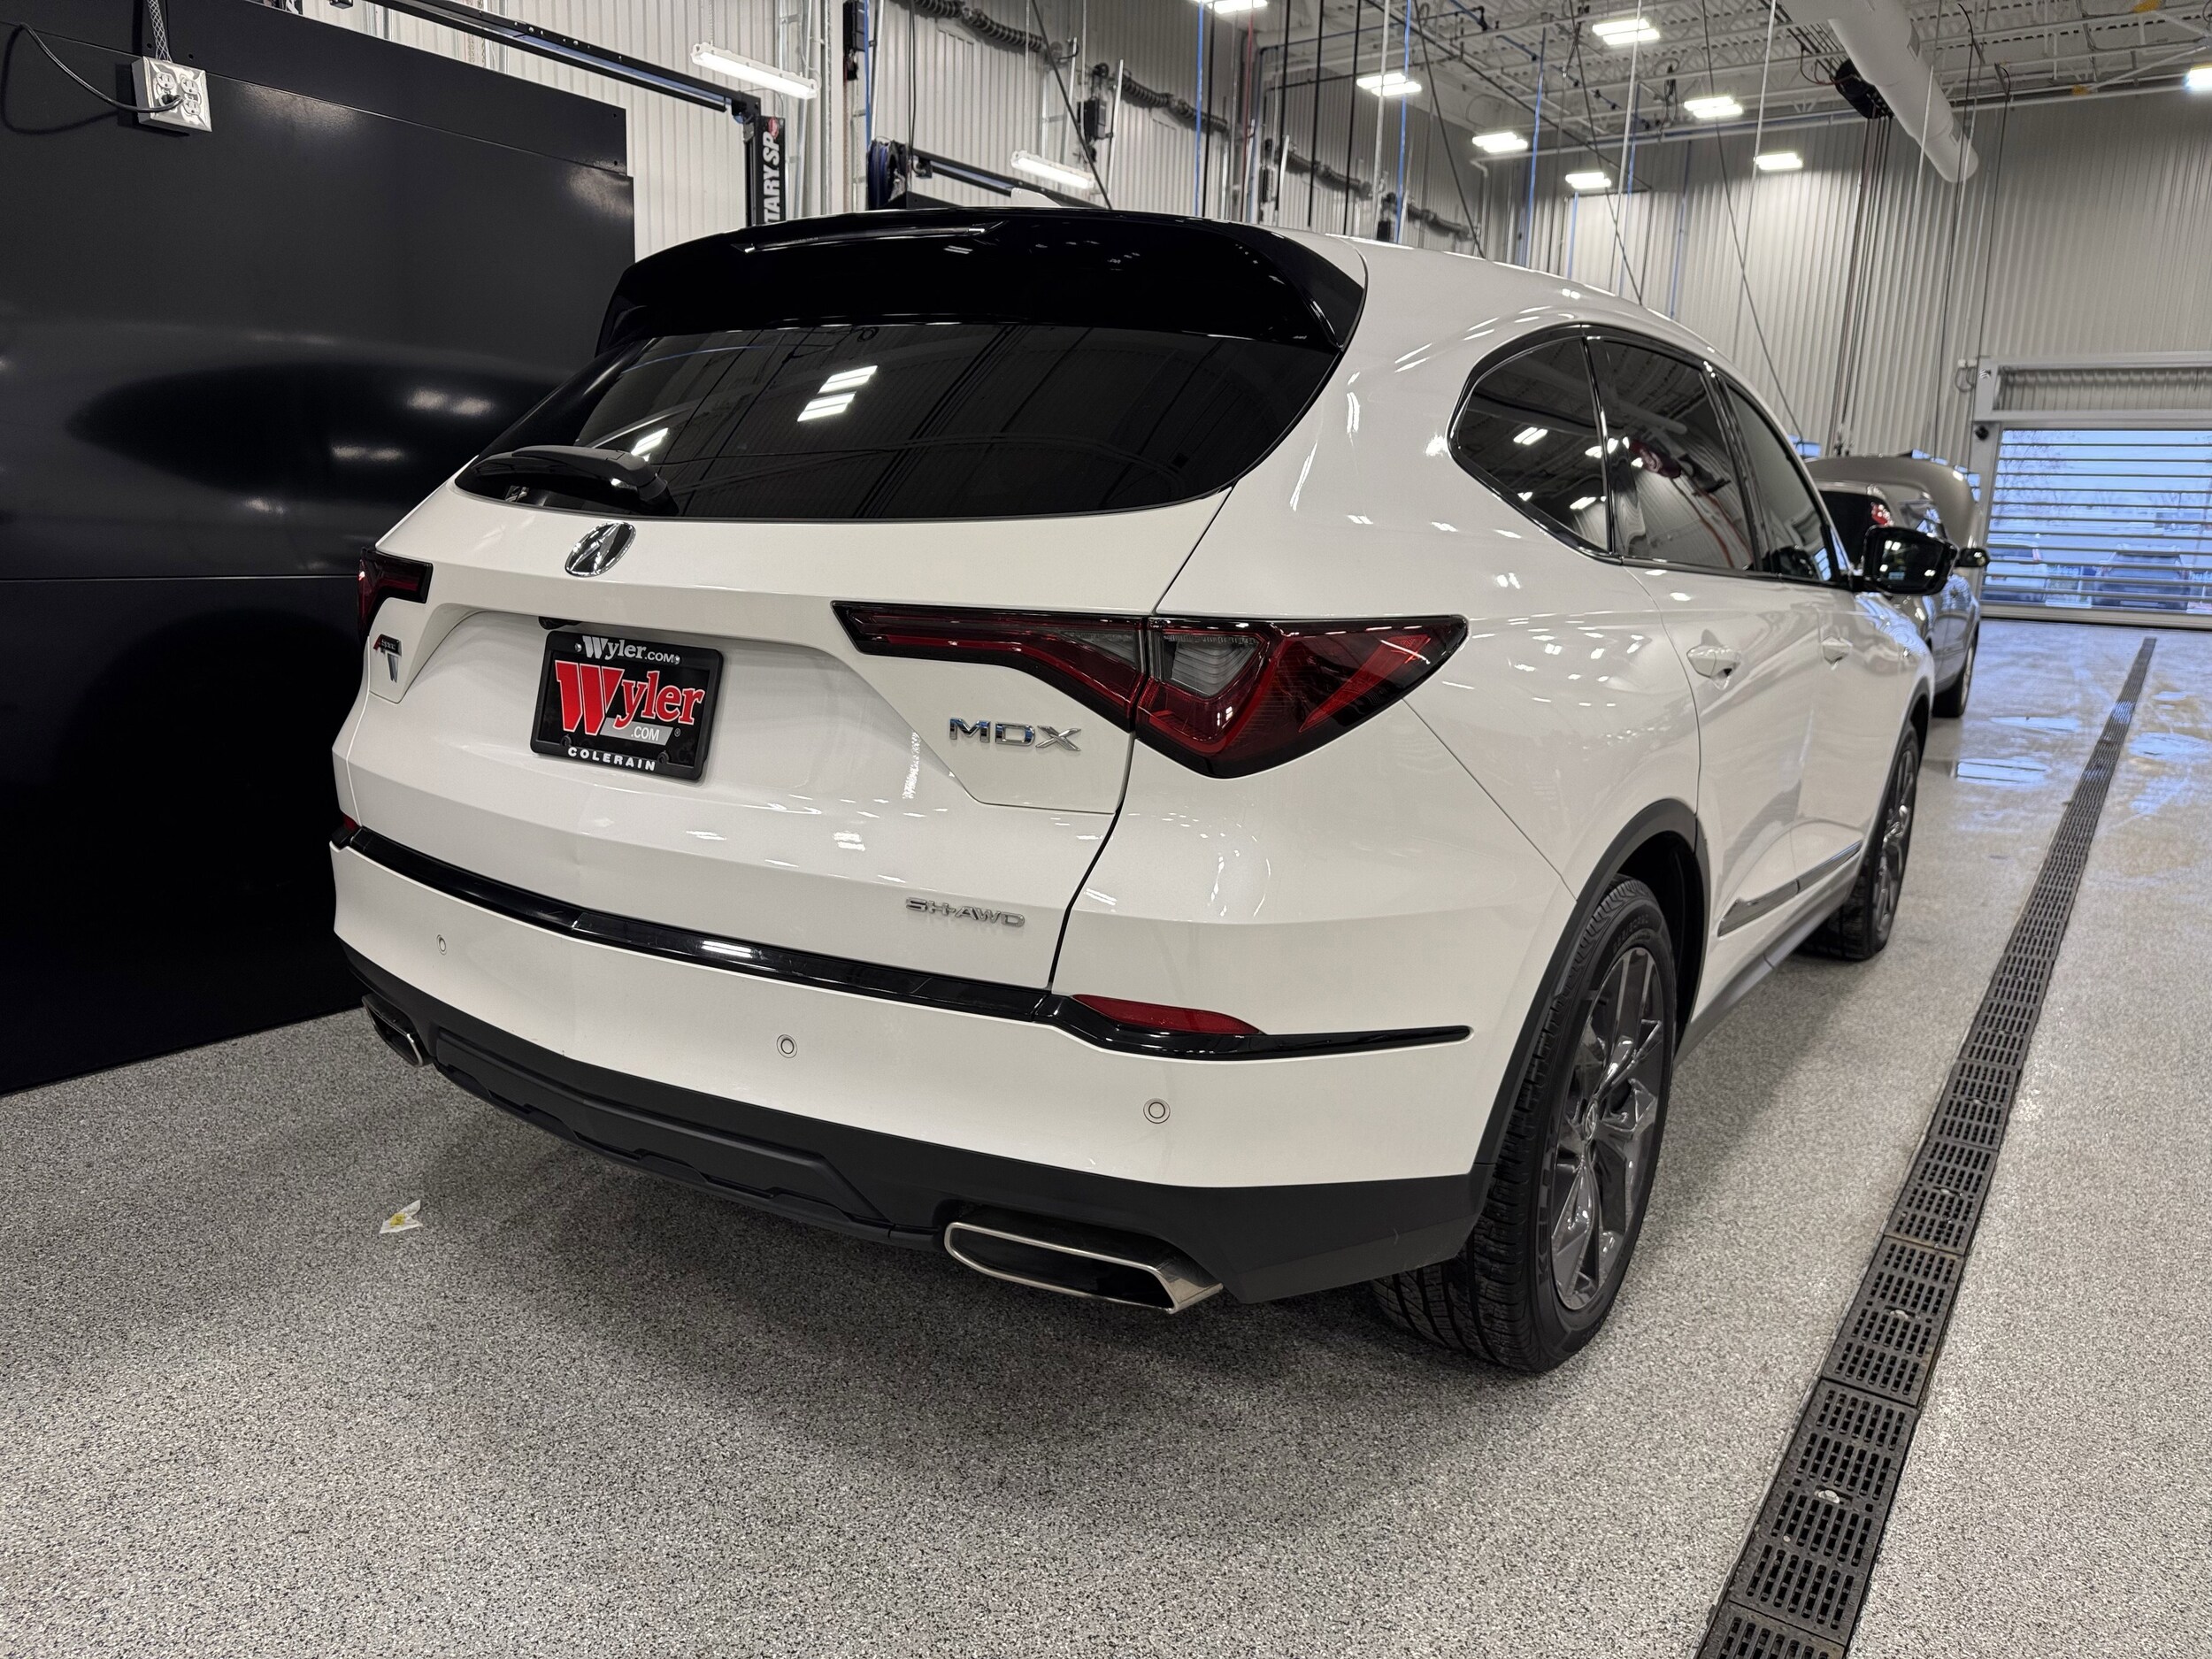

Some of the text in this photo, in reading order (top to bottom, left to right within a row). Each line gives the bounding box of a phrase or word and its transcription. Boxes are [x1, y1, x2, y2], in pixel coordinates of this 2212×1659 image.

[555, 659, 705, 736] Wyler
[631, 726, 660, 741] .COM
[949, 717, 1081, 751] MDX
[567, 747, 656, 772] COLERAIN
[906, 897, 1025, 928] SH-AWD
